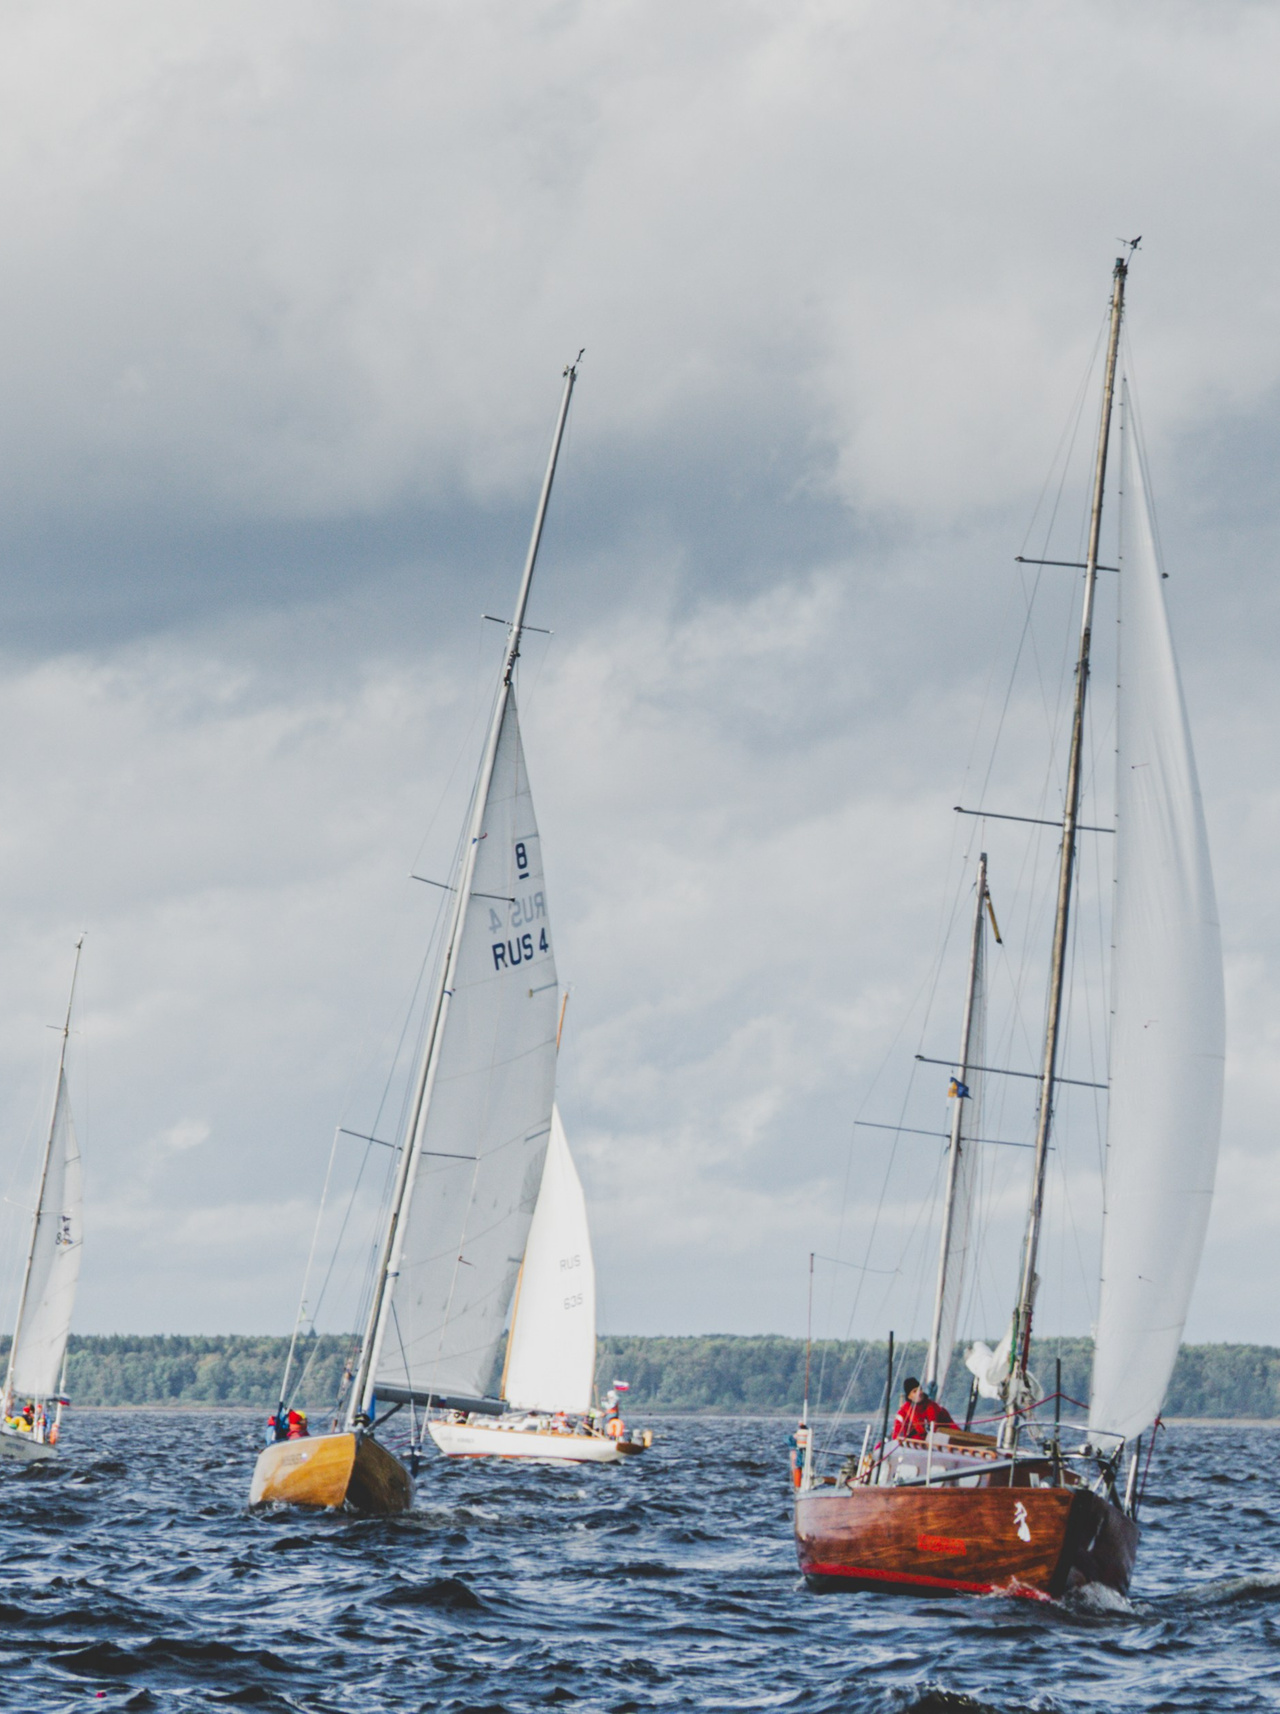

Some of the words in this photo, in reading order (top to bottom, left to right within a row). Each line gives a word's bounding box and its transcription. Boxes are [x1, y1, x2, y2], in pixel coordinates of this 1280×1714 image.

[515, 842, 528, 870] 8
[492, 932, 534, 971] RUS
[538, 927, 549, 954] 4
[559, 1254, 581, 1273] RUS
